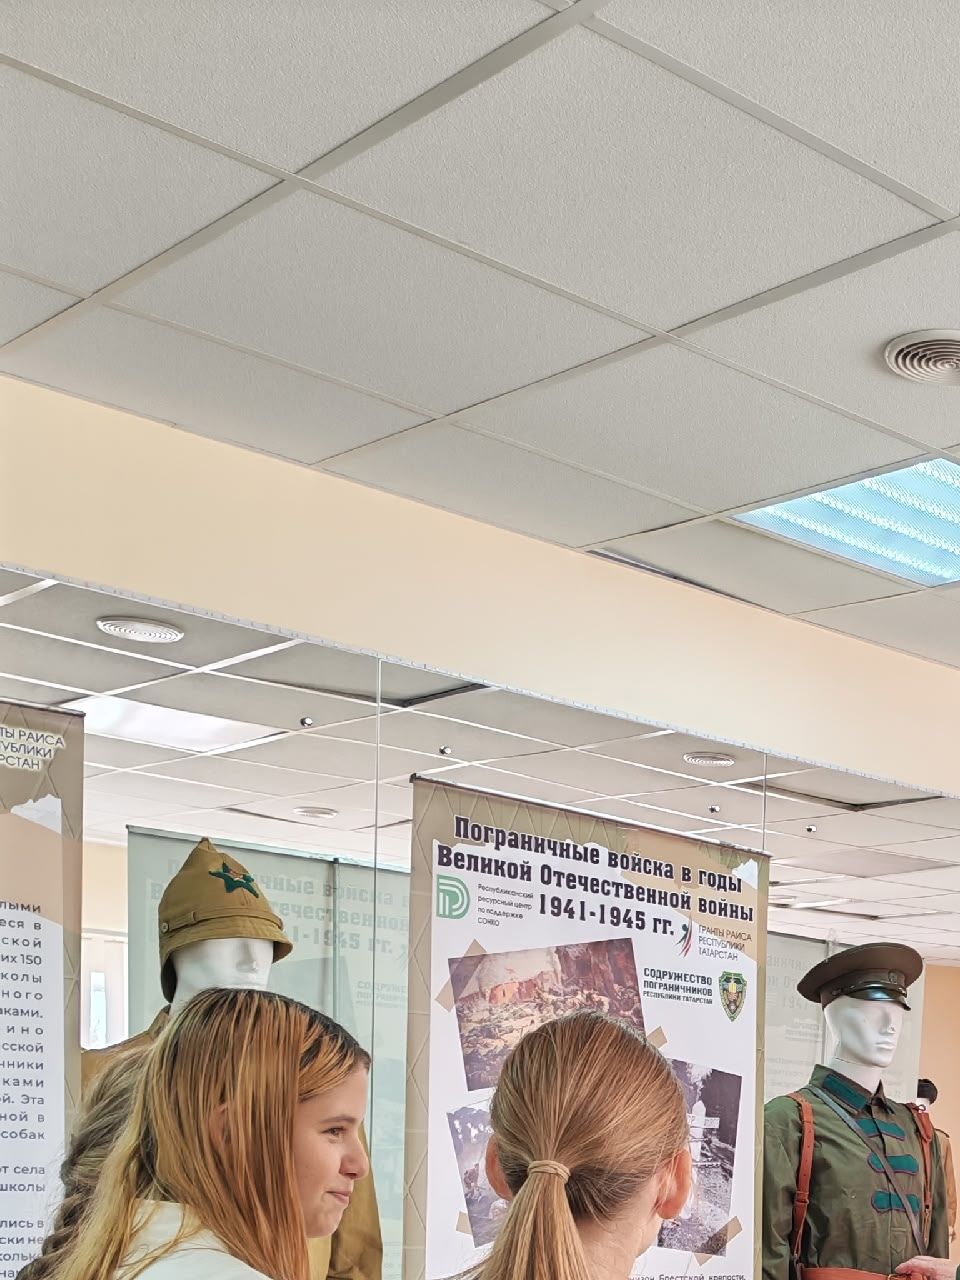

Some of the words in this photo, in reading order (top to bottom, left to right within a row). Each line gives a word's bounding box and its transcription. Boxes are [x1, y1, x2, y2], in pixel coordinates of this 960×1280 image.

[19, 731, 64, 746] РАИСА
[455, 816, 599, 864] Пограничные
[608, 852, 673, 879] войска
[682, 867, 691, 881] в
[699, 870, 742, 892] годы
[438, 845, 532, 881] Великой
[541, 864, 691, 910] Отечественной
[699, 898, 753, 921] войны
[478, 884, 533, 898] Республиканский
[540, 894, 645, 930] 1941-1945
[653, 918, 674, 935] гг.
[699, 925, 724, 937] ГРАНТЫ
[726, 930, 751, 941] РАИСА
[699, 937, 745, 950] РЕСПУБЛИКИ
[20, 954, 42, 965] 150
[699, 948, 738, 961] ТАТАРСТАН
[644, 968, 712, 986] СОДРУЖЕСТВО
[644, 981, 712, 996] ПОГРАНИЧНИКОВ
[21, 1095, 44, 1104] Эта
[13, 1165, 45, 1174] села
